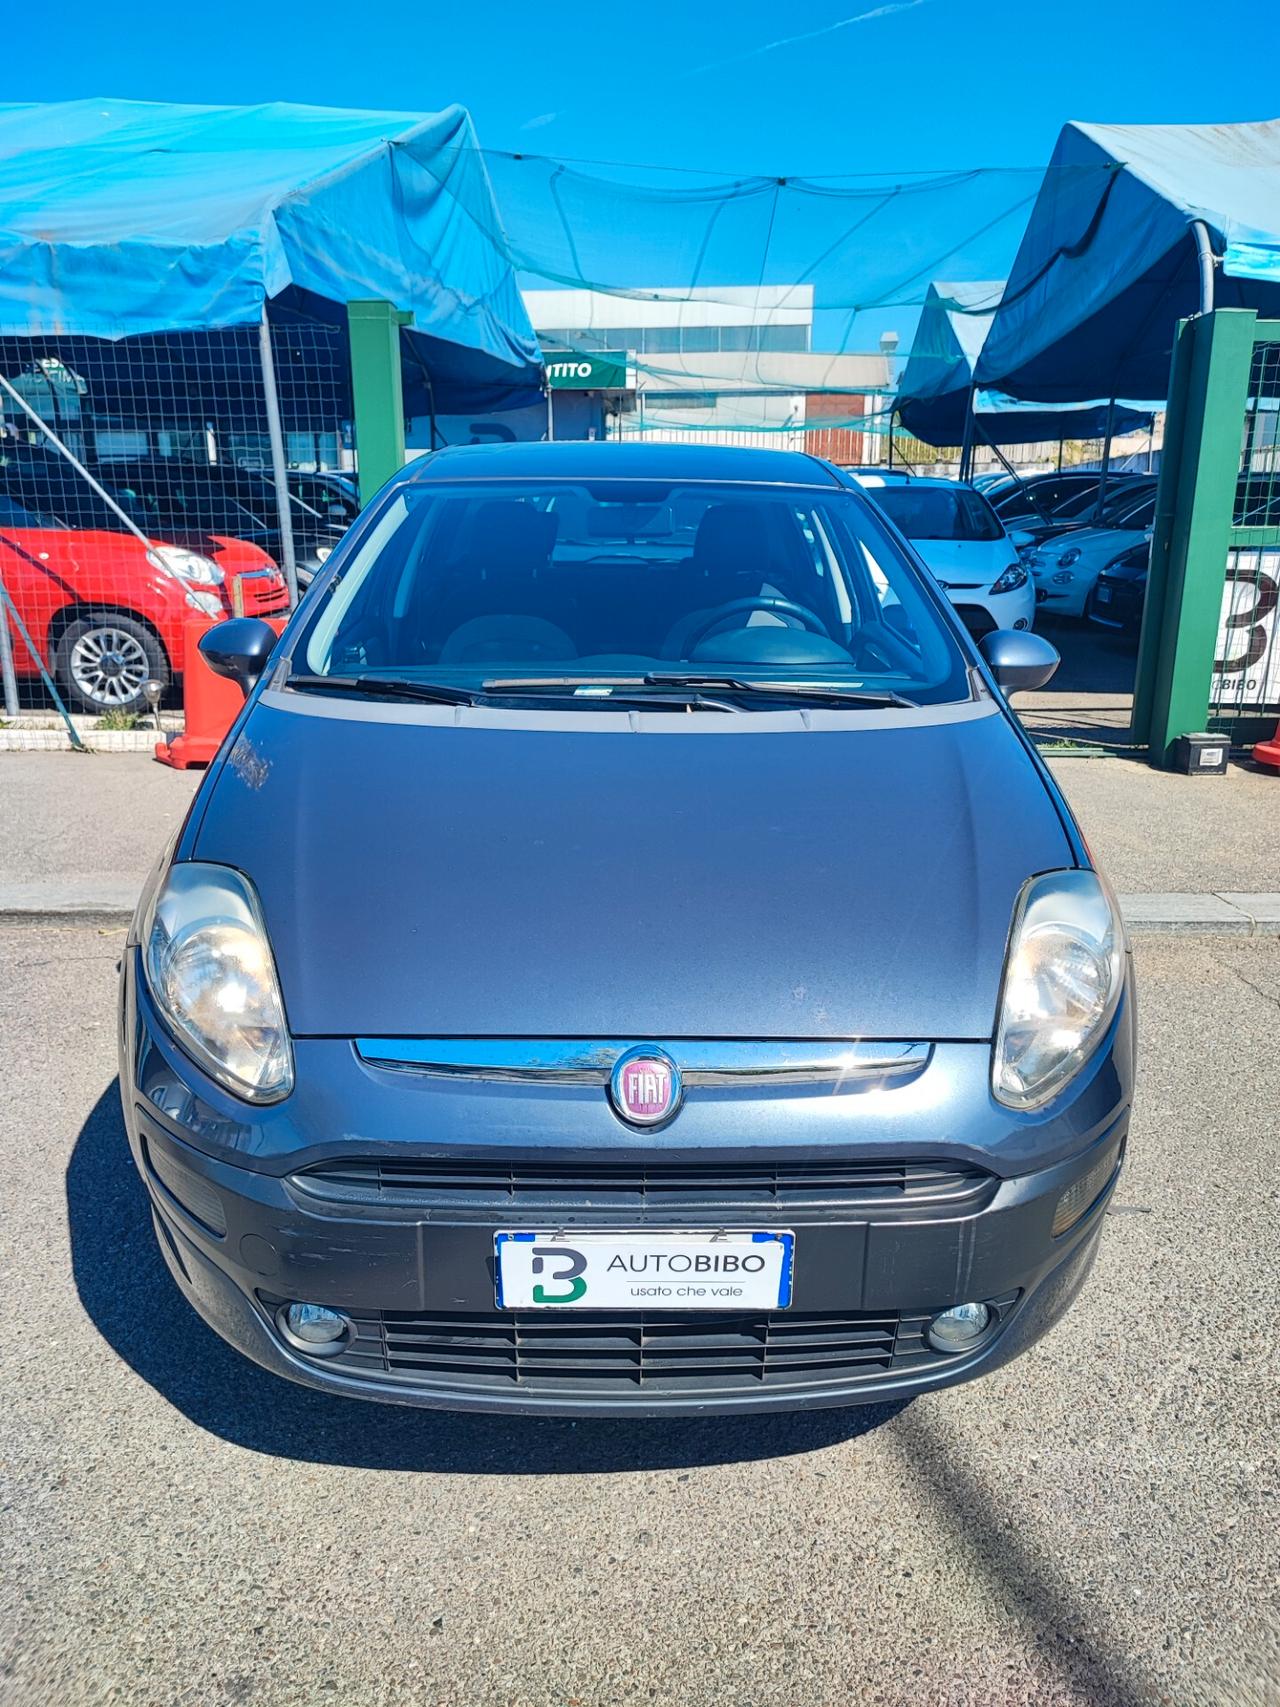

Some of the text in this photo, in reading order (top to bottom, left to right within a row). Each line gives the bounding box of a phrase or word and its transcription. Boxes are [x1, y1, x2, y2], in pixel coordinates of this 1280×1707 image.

[628, 1072, 667, 1105] FIAT
[606, 1254, 766, 1273] AUTOBIBO
[630, 1286, 744, 1297] usato che vale
